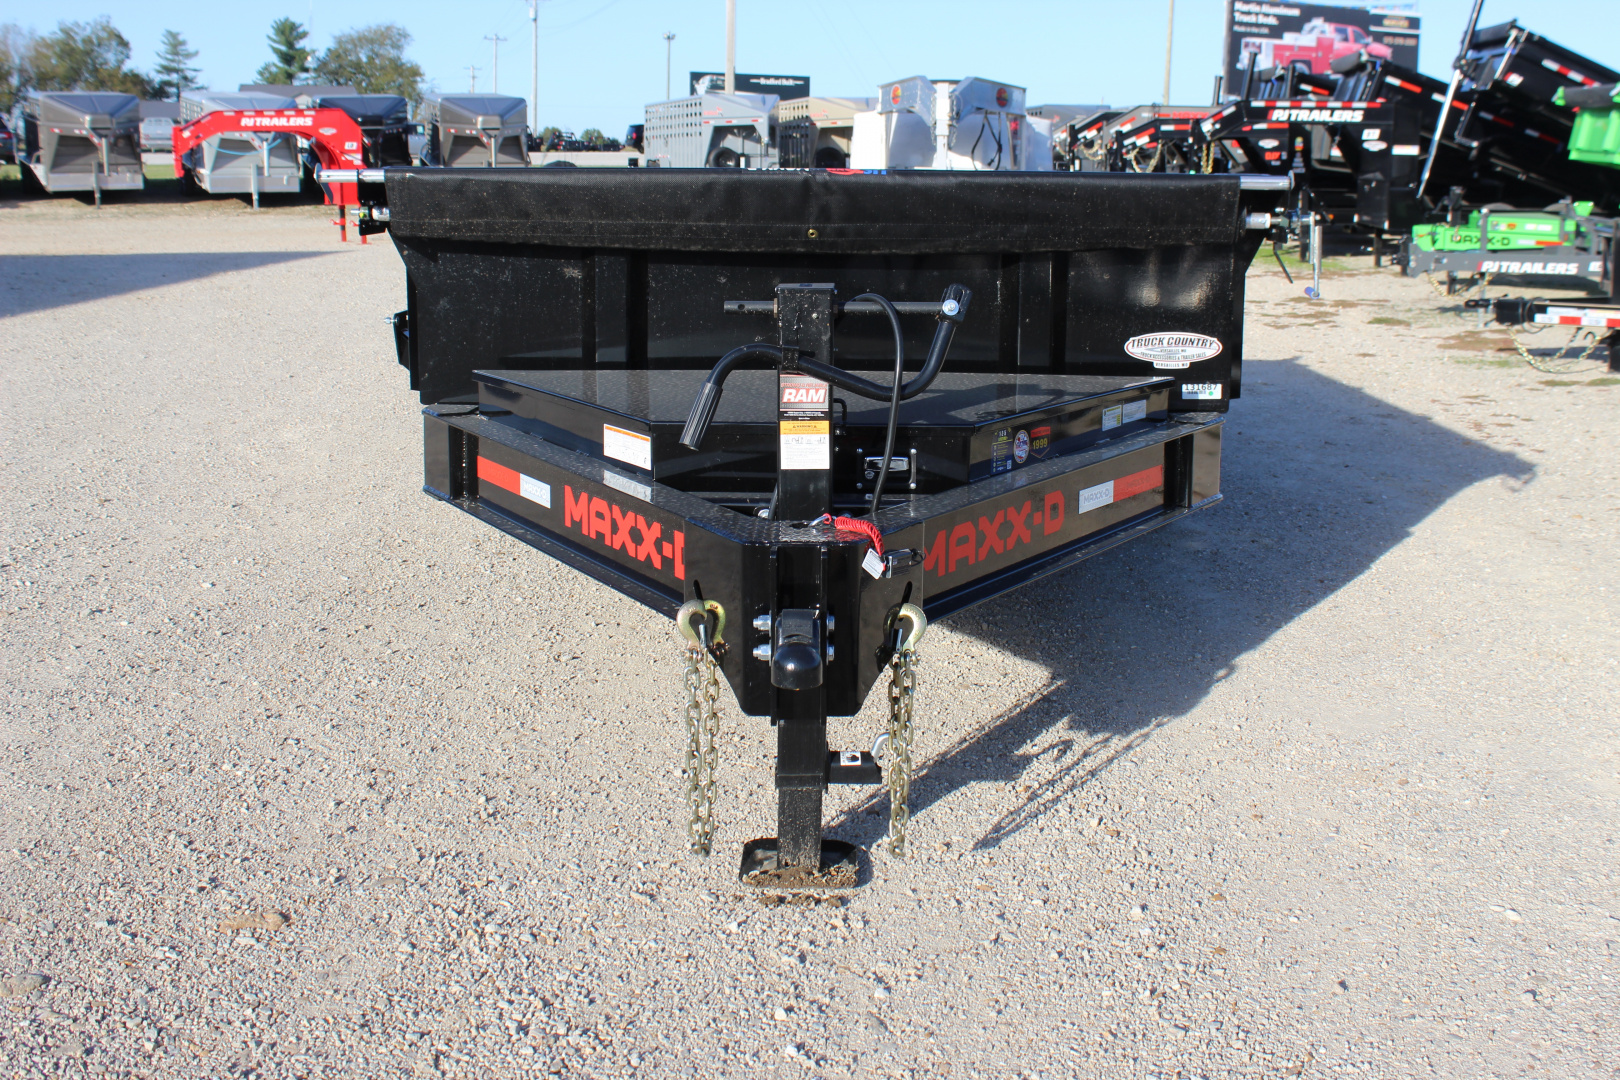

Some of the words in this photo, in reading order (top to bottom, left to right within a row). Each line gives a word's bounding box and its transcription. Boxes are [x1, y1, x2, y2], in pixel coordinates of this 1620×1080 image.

[1131, 337, 1164, 348] TRUCK
[1166, 336, 1215, 348] COUNTRY
[1184, 383, 1217, 391] 131687
[782, 388, 826, 403] RAM
[1033, 437, 1048, 450] 1999
[1083, 488, 1110, 504] MAXX-D
[923, 490, 1065, 577] MAXX-D
